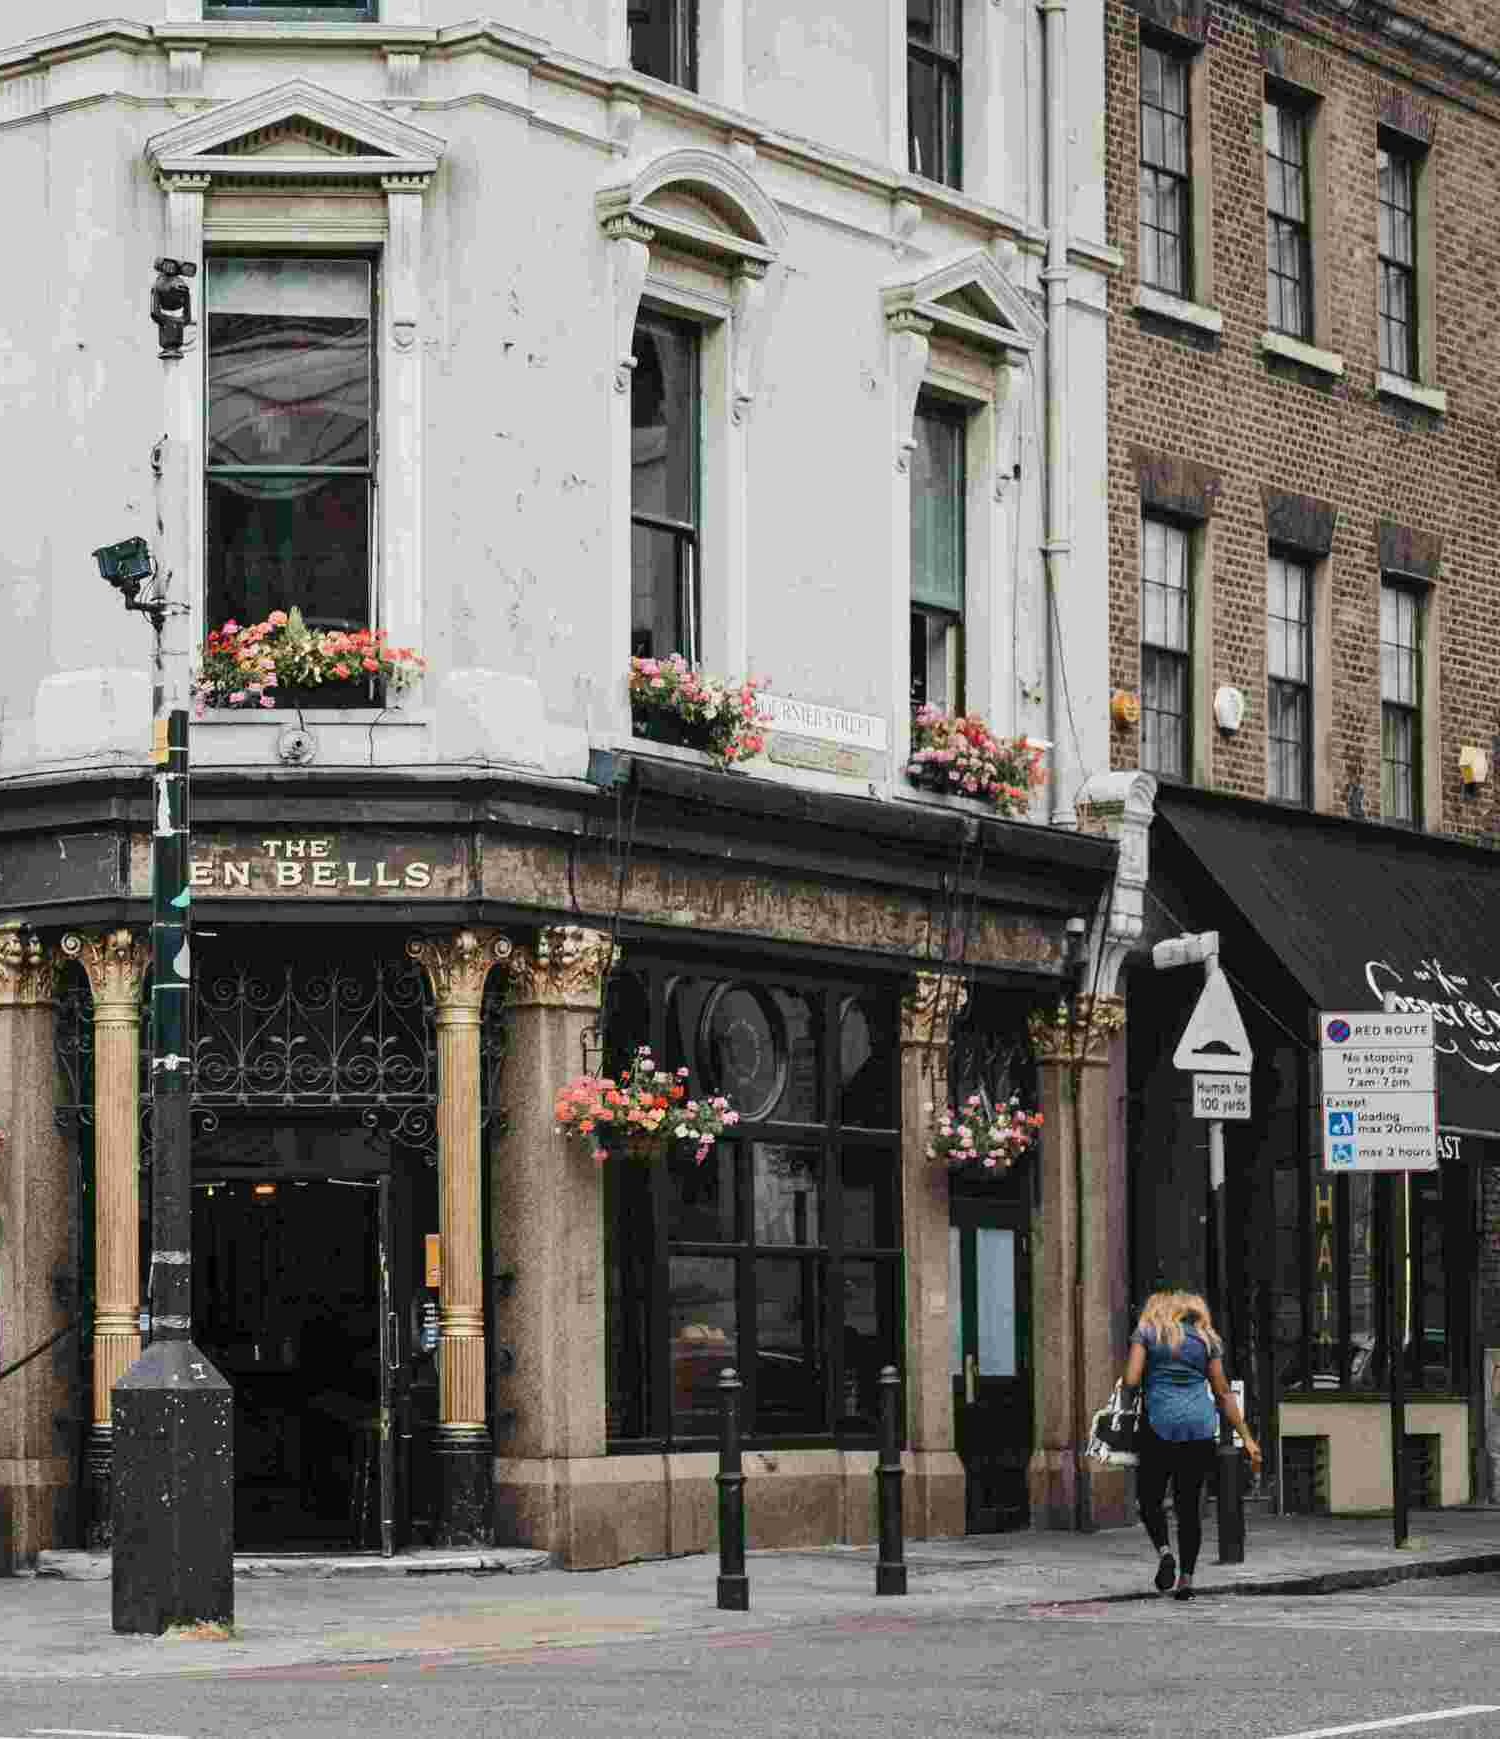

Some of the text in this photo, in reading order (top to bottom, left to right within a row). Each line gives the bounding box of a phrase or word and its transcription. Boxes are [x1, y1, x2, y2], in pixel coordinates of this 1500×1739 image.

[263, 840, 331, 858] THE
[189, 862, 430, 888] EN BELLS
[1356, 1023, 1429, 1036] RED ROUTE
[1363, 1052, 1414, 1065] stopping
[1347, 1065, 1410, 1077] on any day
[1197, 1079, 1247, 1096] Humps for
[1200, 1096, 1247, 1115] 100 yards
[1357, 1111, 1402, 1123] loading
[1358, 1125, 1383, 1135] max
[1358, 1148, 1382, 1158] max
[1398, 1147, 1431, 1158] hours
